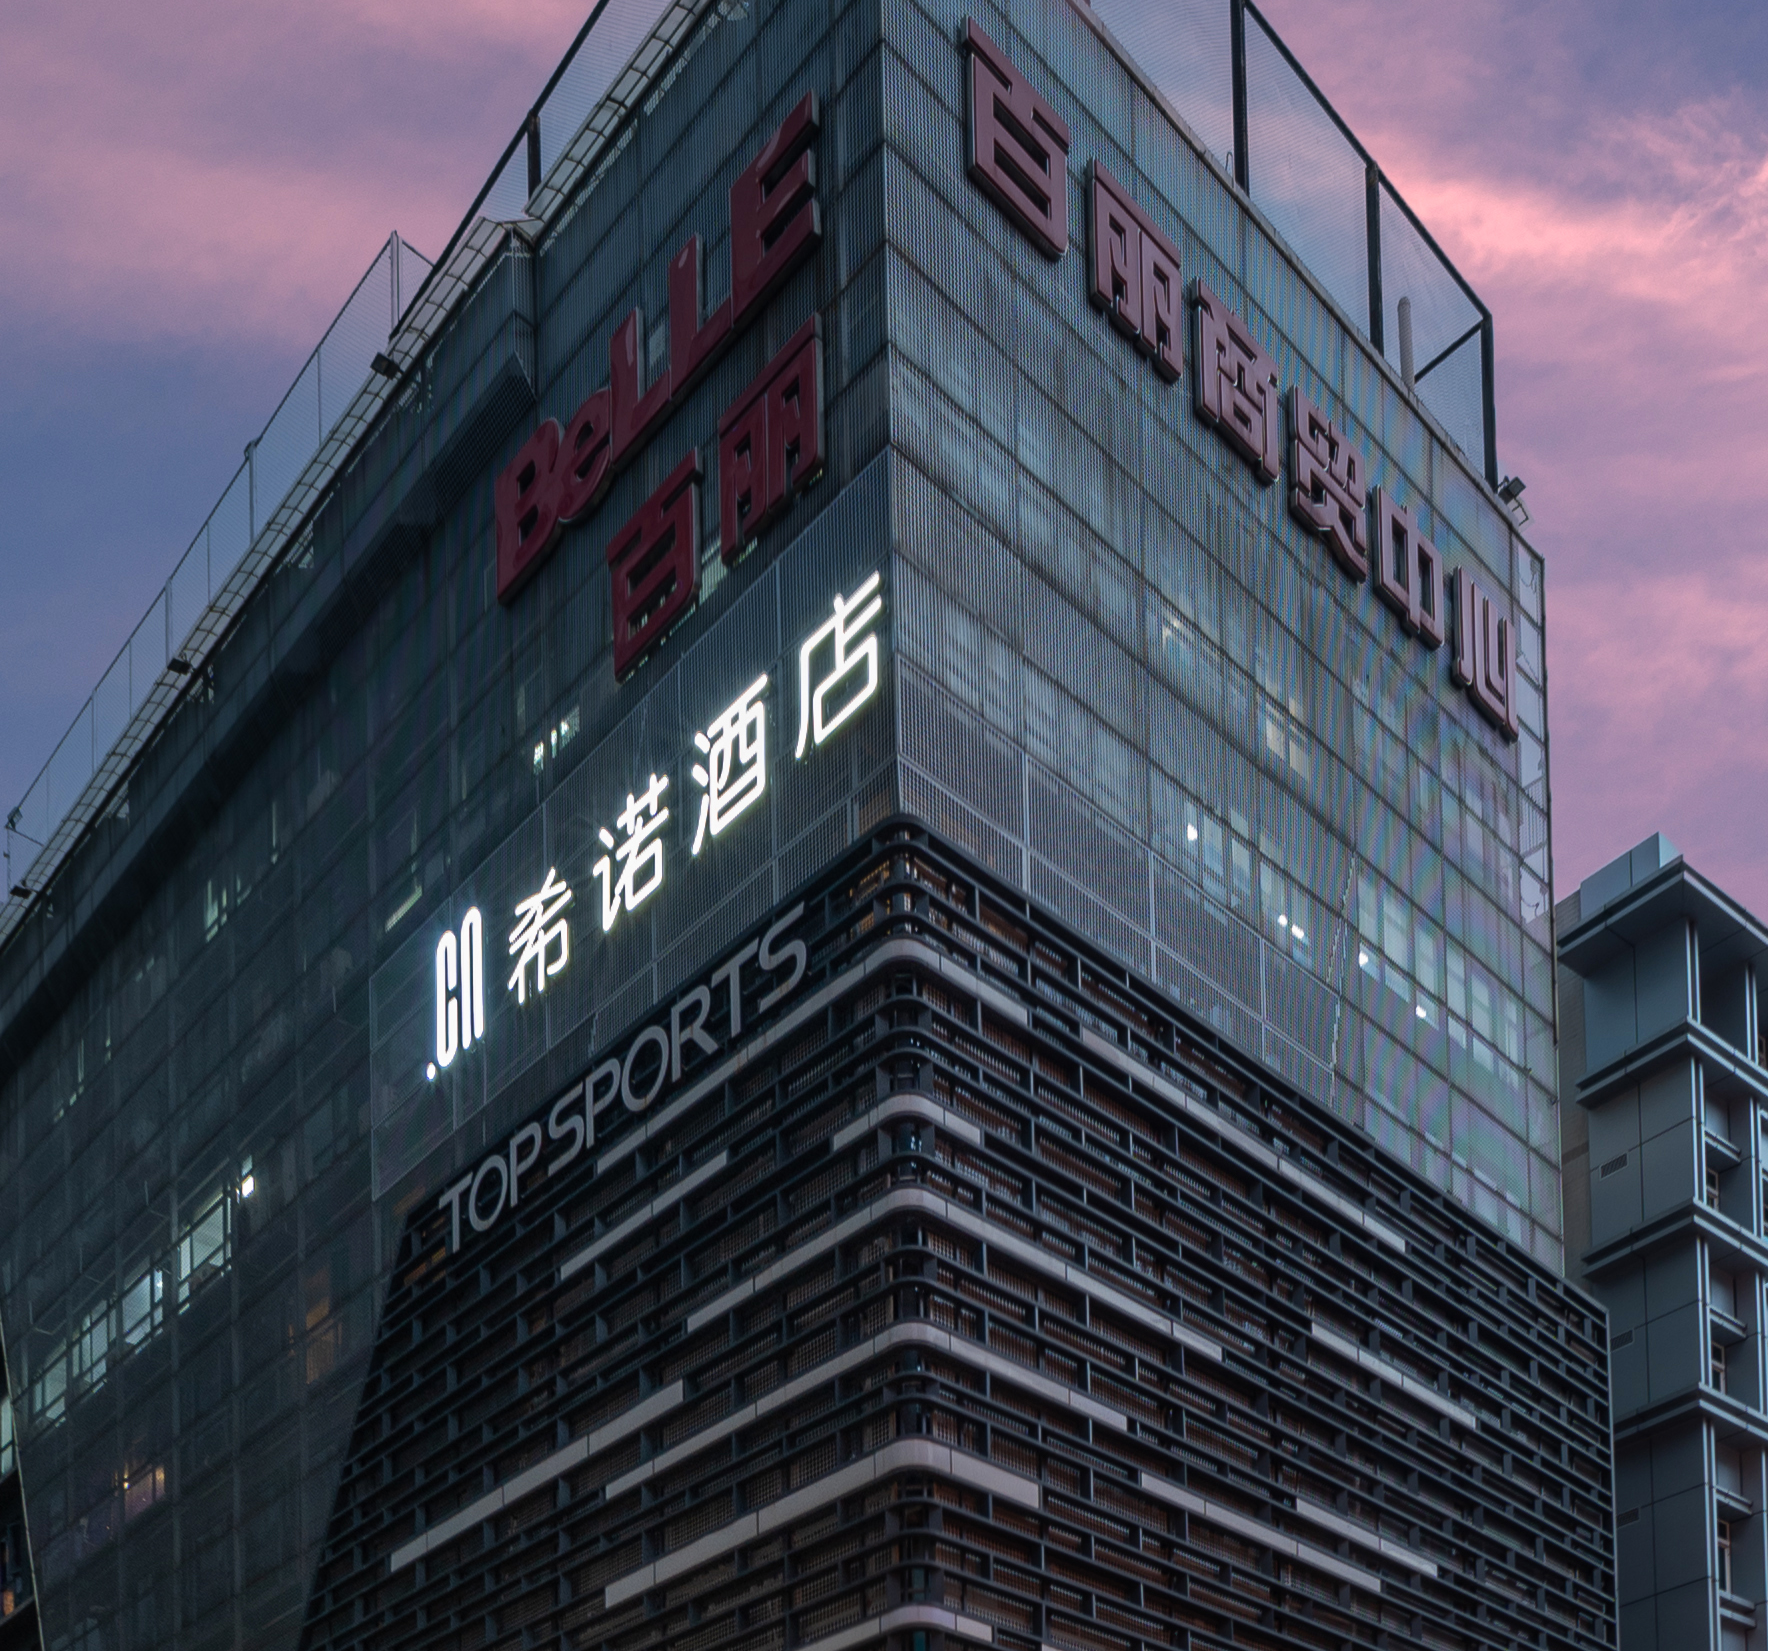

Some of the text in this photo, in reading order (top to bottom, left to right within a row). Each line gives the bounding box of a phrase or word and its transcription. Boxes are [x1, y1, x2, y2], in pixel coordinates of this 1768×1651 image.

[607, 314, 826, 680] 百丽
[962, 17, 1517, 740] 百丽商贸中心
[509, 573, 881, 1003] 希诺酒店
[438, 901, 812, 1254] TOPSPORTS
